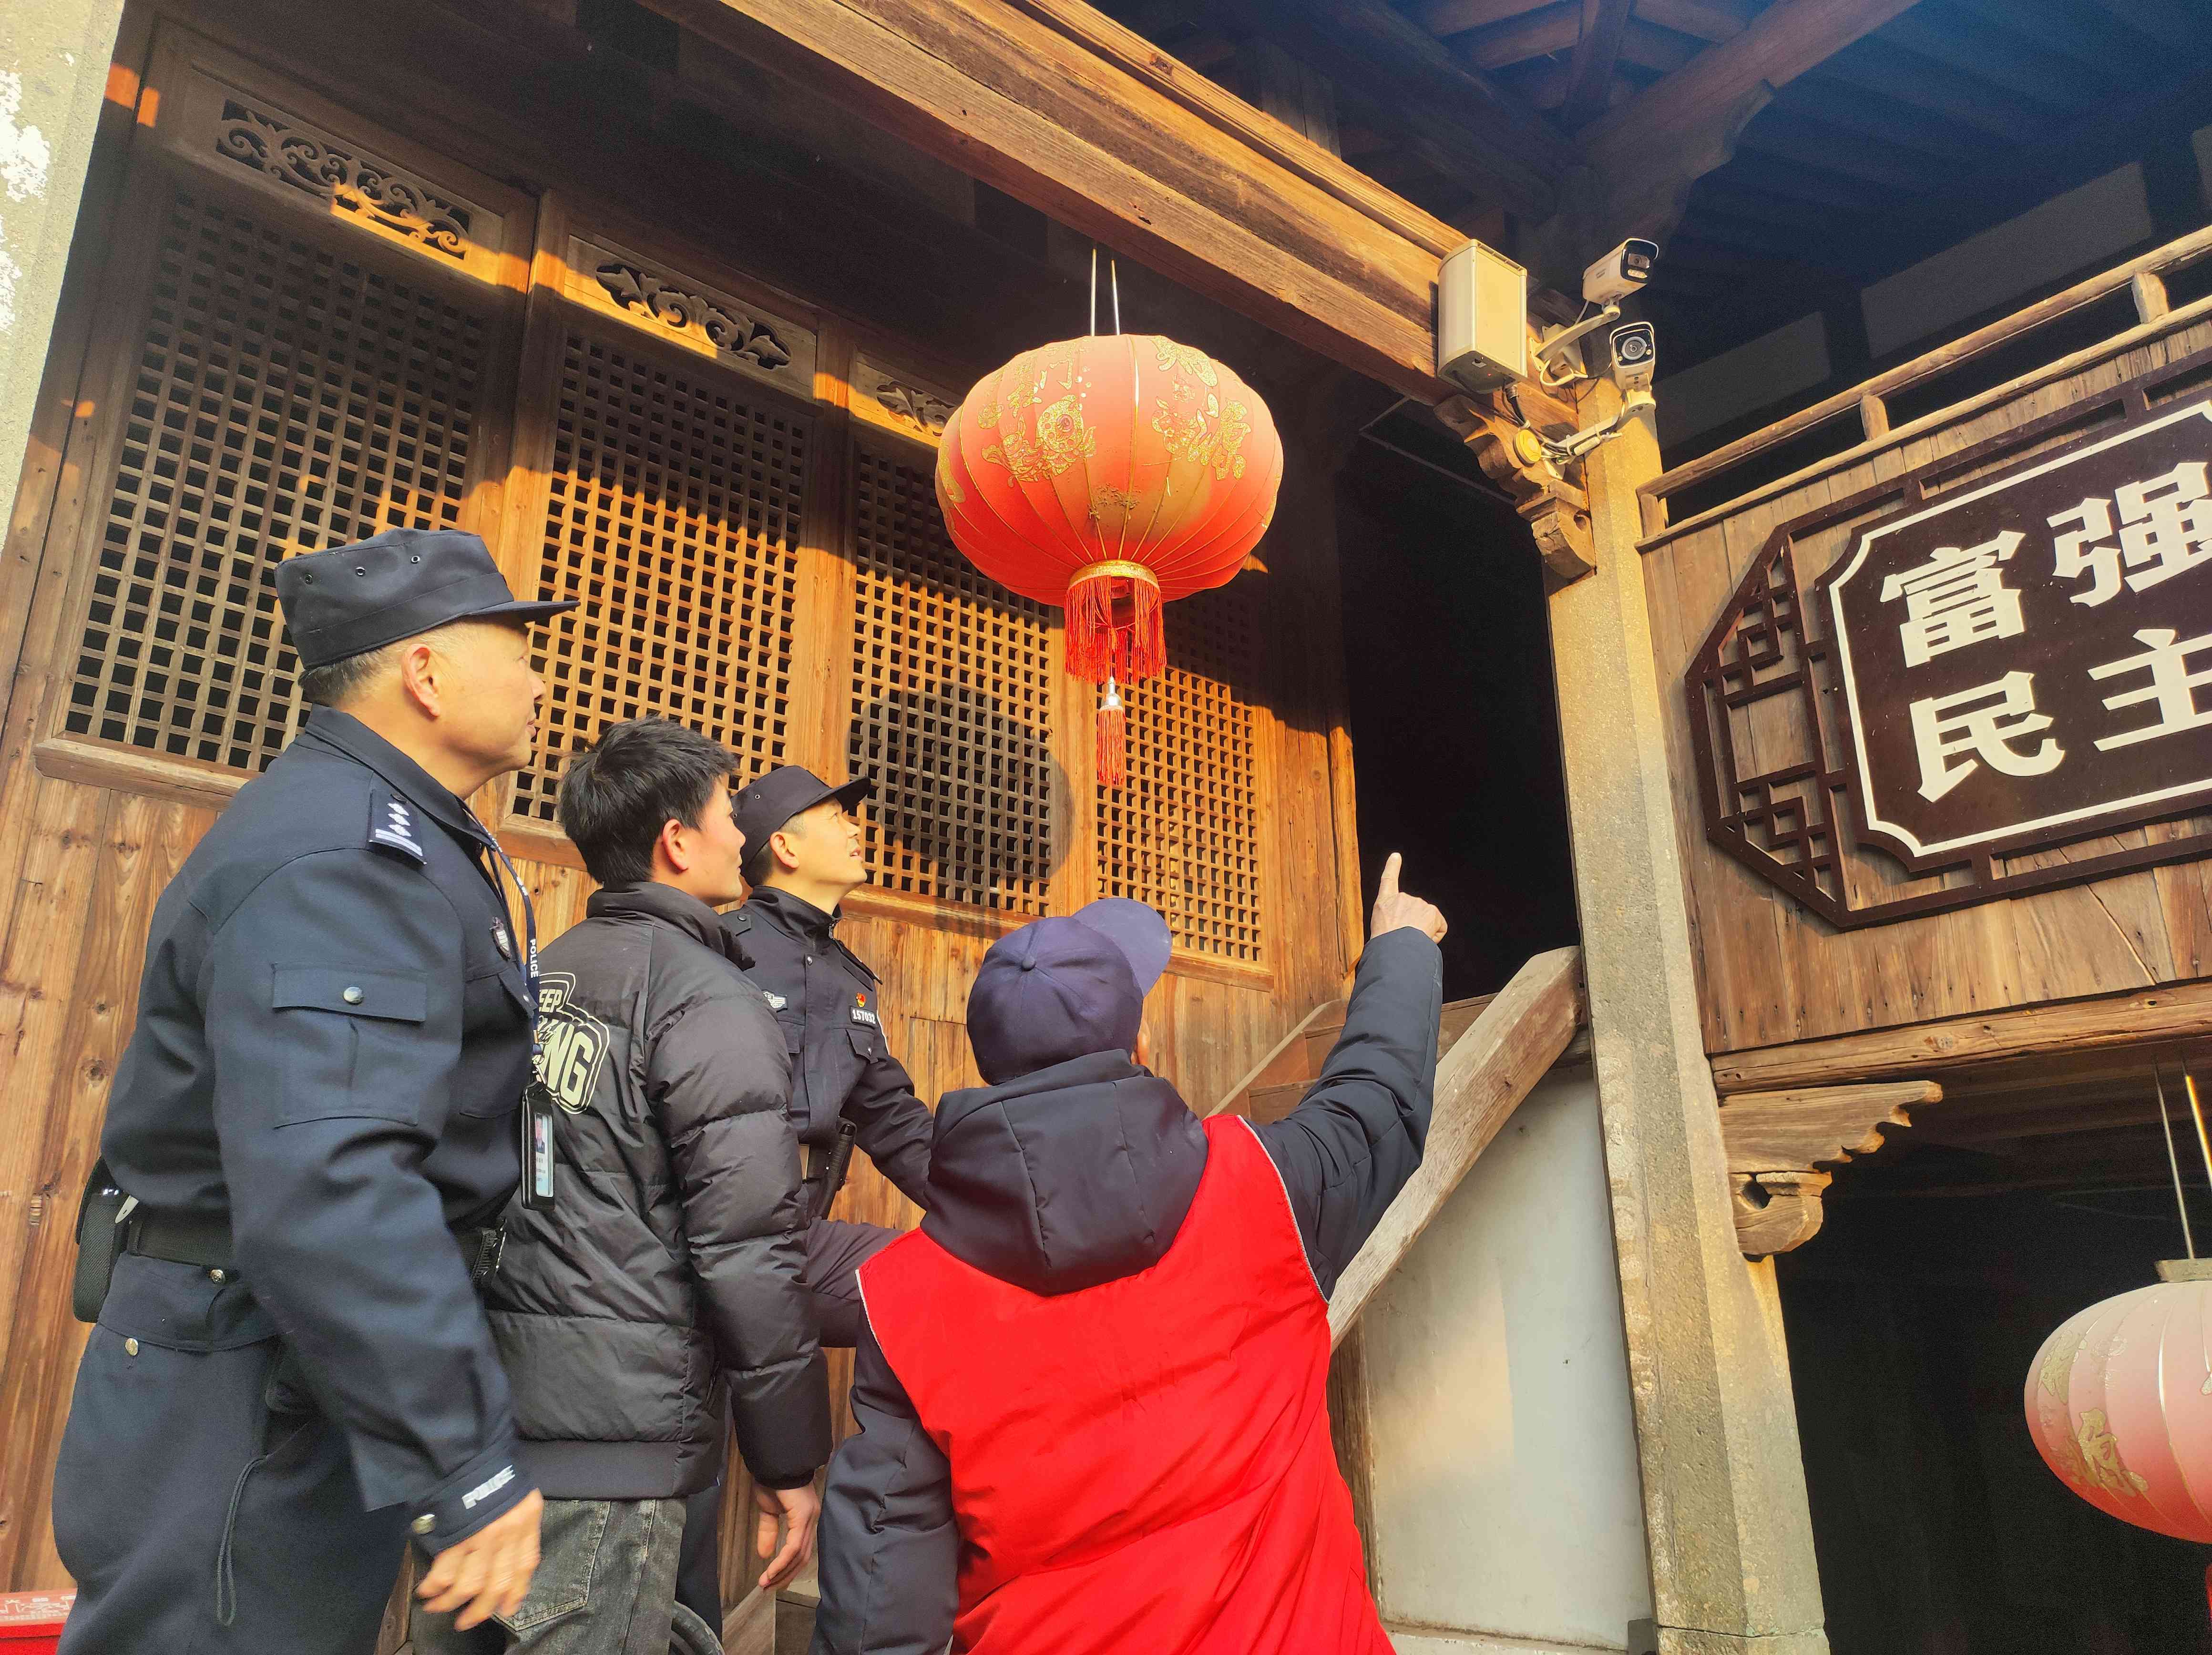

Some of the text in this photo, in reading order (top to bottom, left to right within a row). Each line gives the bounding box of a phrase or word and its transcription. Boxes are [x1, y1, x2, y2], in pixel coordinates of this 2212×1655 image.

[1880, 462, 2212, 668] 富强
[1909, 628, 2212, 803] 民主
[530, 938, 539, 978] POLICE
[539, 989, 563, 1013] EEP
[852, 1009, 876, 1024] 157032
[538, 1019, 594, 1105] NG
